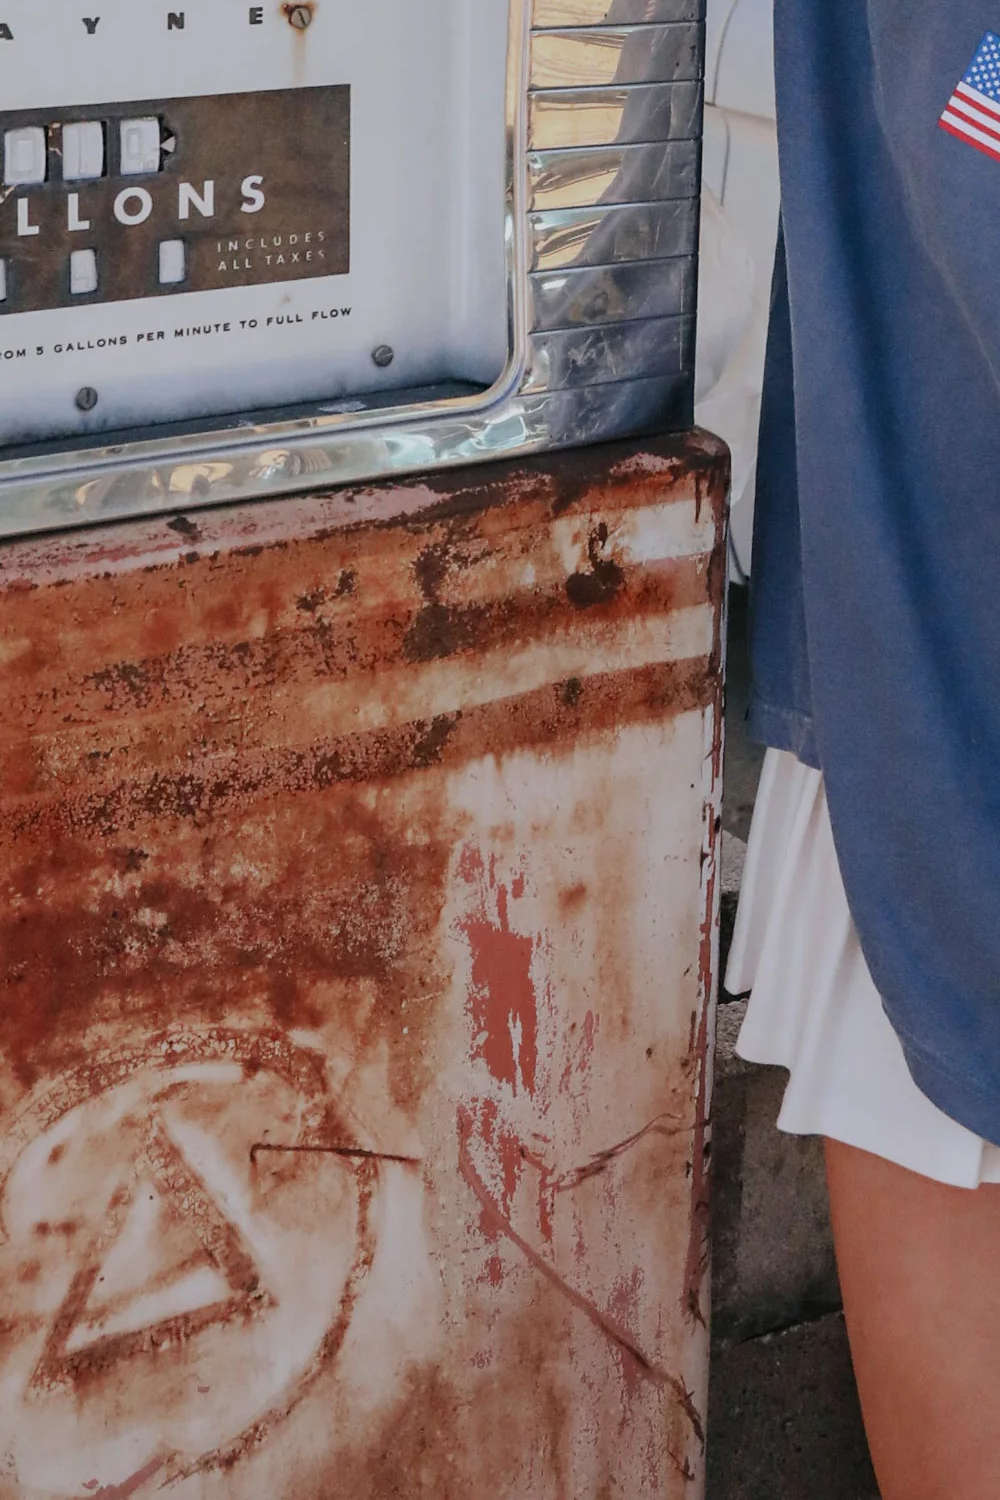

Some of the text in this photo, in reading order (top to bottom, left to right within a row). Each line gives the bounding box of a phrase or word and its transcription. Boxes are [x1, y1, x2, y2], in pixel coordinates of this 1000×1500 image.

[217, 231, 326, 253] INCLUDES
[218, 250, 325, 271] ALL TAXES
[0, 307, 352, 360] OM 5 GALLONS PER MINUTE TO FULL FLOW
